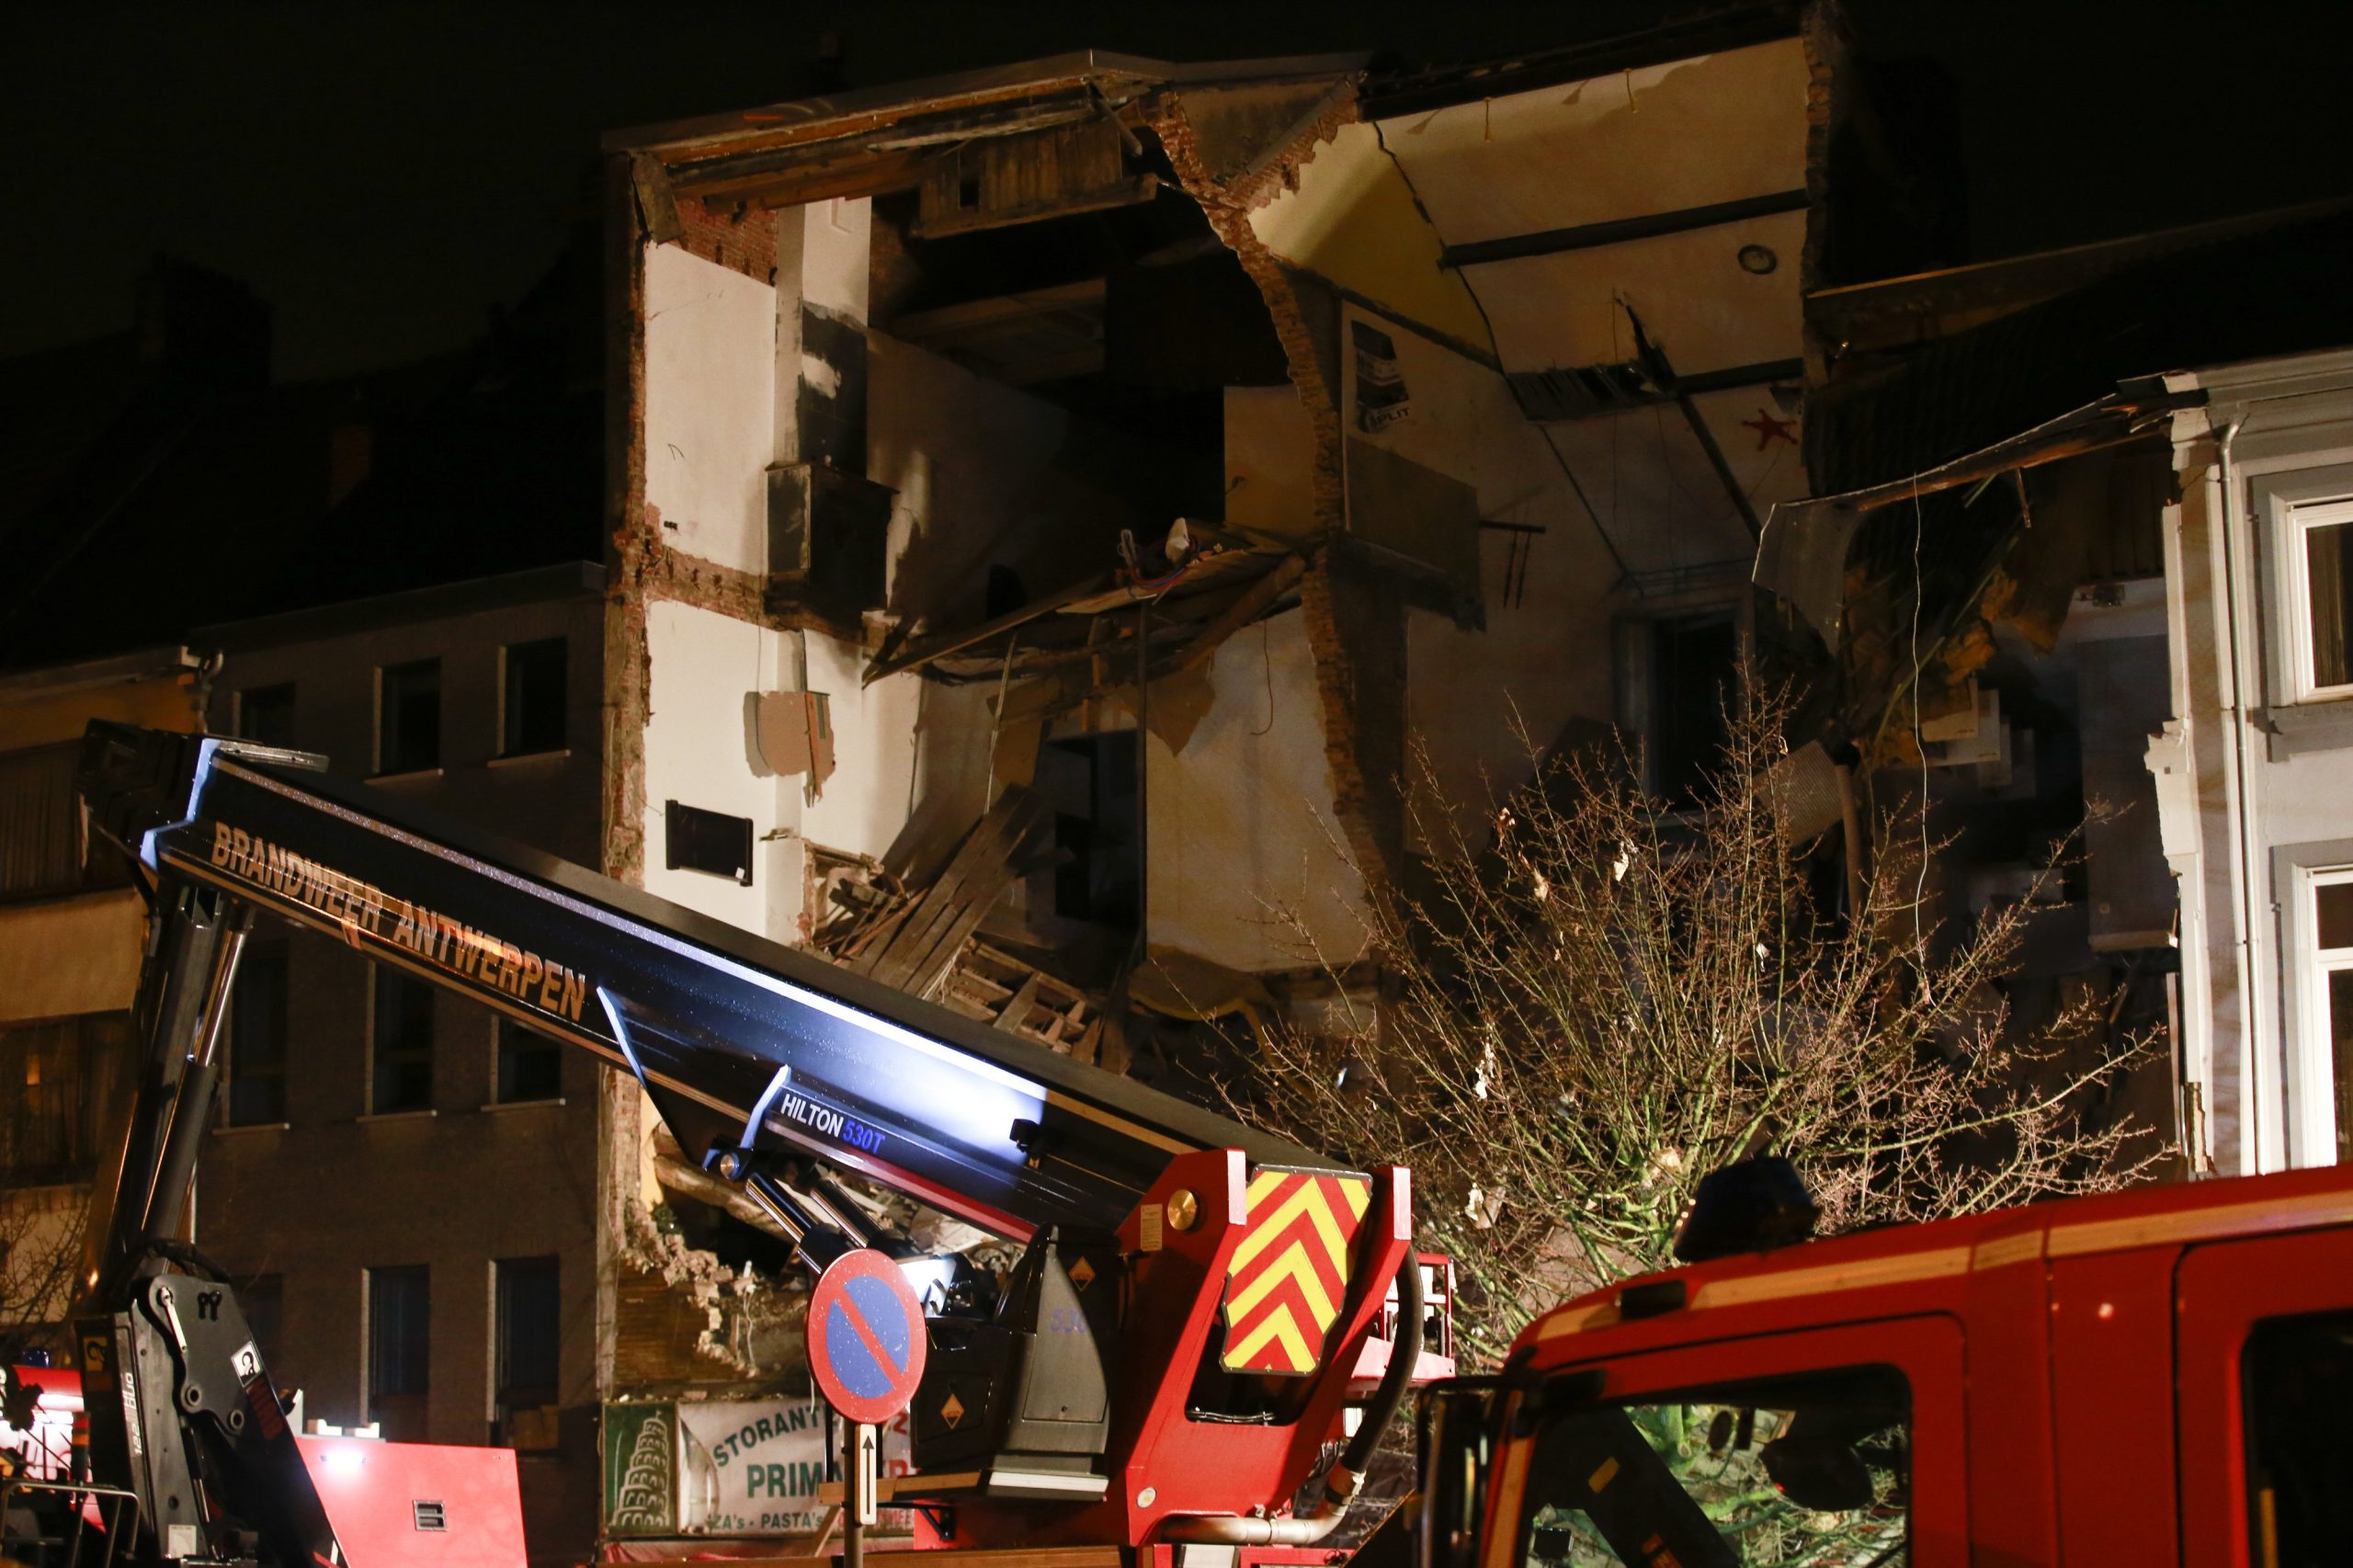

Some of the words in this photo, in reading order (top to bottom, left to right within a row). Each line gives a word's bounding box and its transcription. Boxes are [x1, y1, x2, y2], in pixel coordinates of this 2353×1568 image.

[211, 821, 383, 933] BRANDWEER
[392, 899, 586, 1022] ANTWERPEN
[779, 1093, 844, 1138] HILTON
[843, 1119, 886, 1154] 530T
